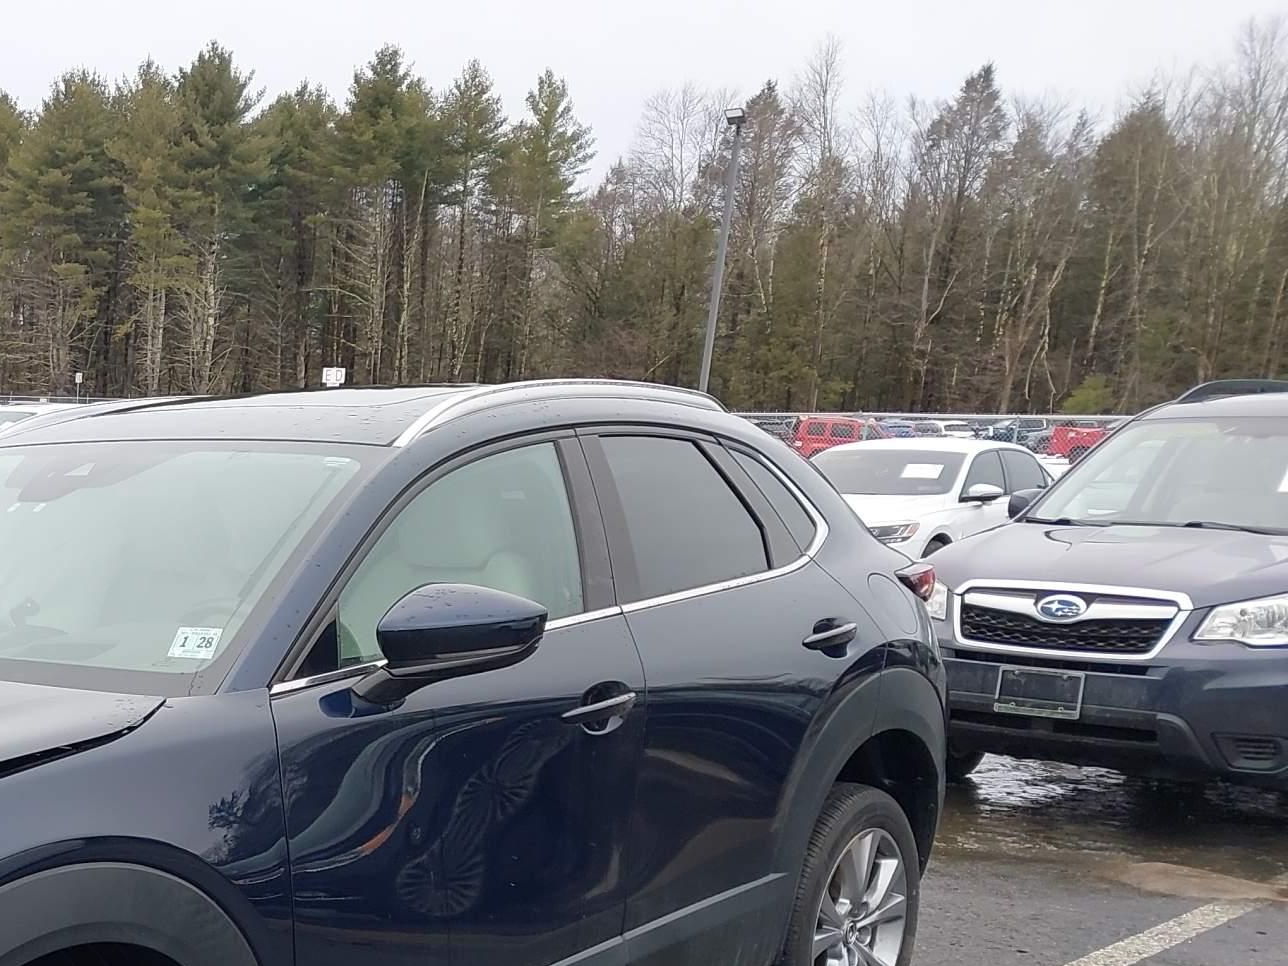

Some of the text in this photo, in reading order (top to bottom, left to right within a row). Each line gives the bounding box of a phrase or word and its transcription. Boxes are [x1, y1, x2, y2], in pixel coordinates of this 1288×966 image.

[325, 369, 343, 382] ED
[179, 636, 214, 649] 1 28
